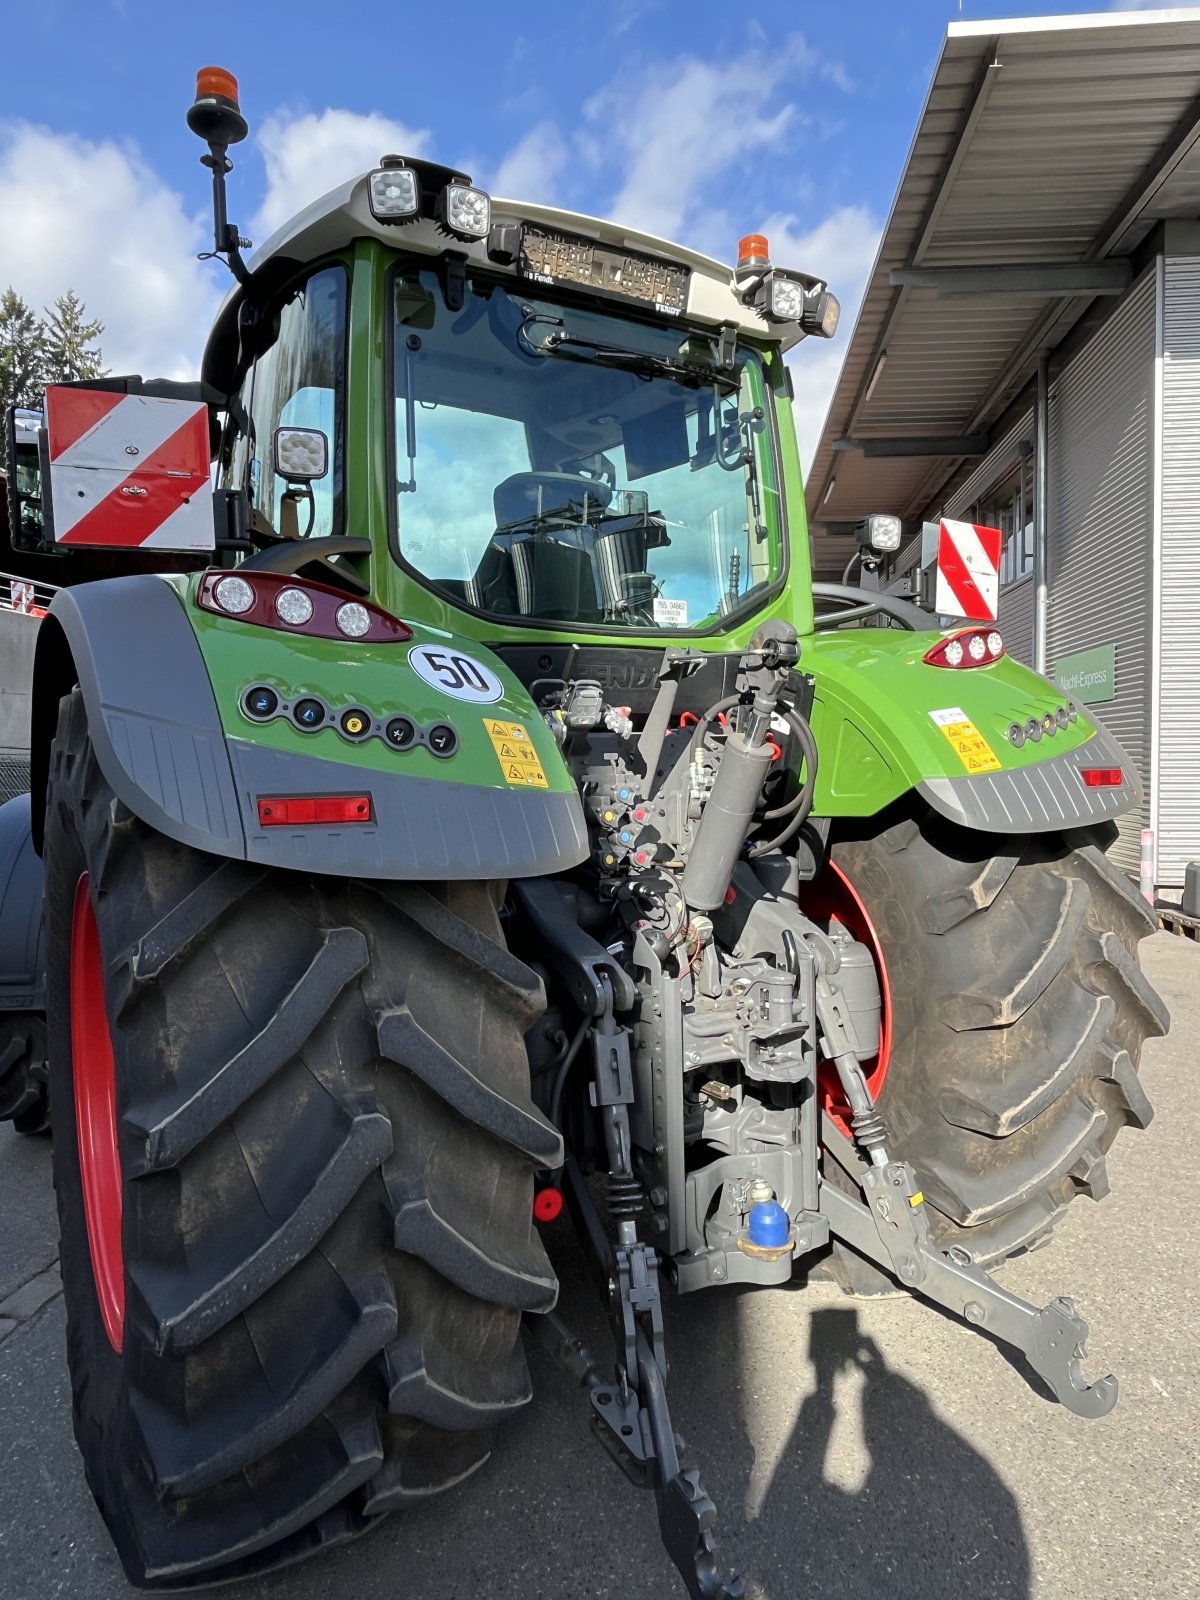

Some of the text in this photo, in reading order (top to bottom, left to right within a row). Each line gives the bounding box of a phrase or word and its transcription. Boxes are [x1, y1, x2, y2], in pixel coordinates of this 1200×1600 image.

[655, 303, 682, 317] FENDT
[421, 652, 490, 693] 50
[1060, 670, 1107, 690] Nacht-Express
